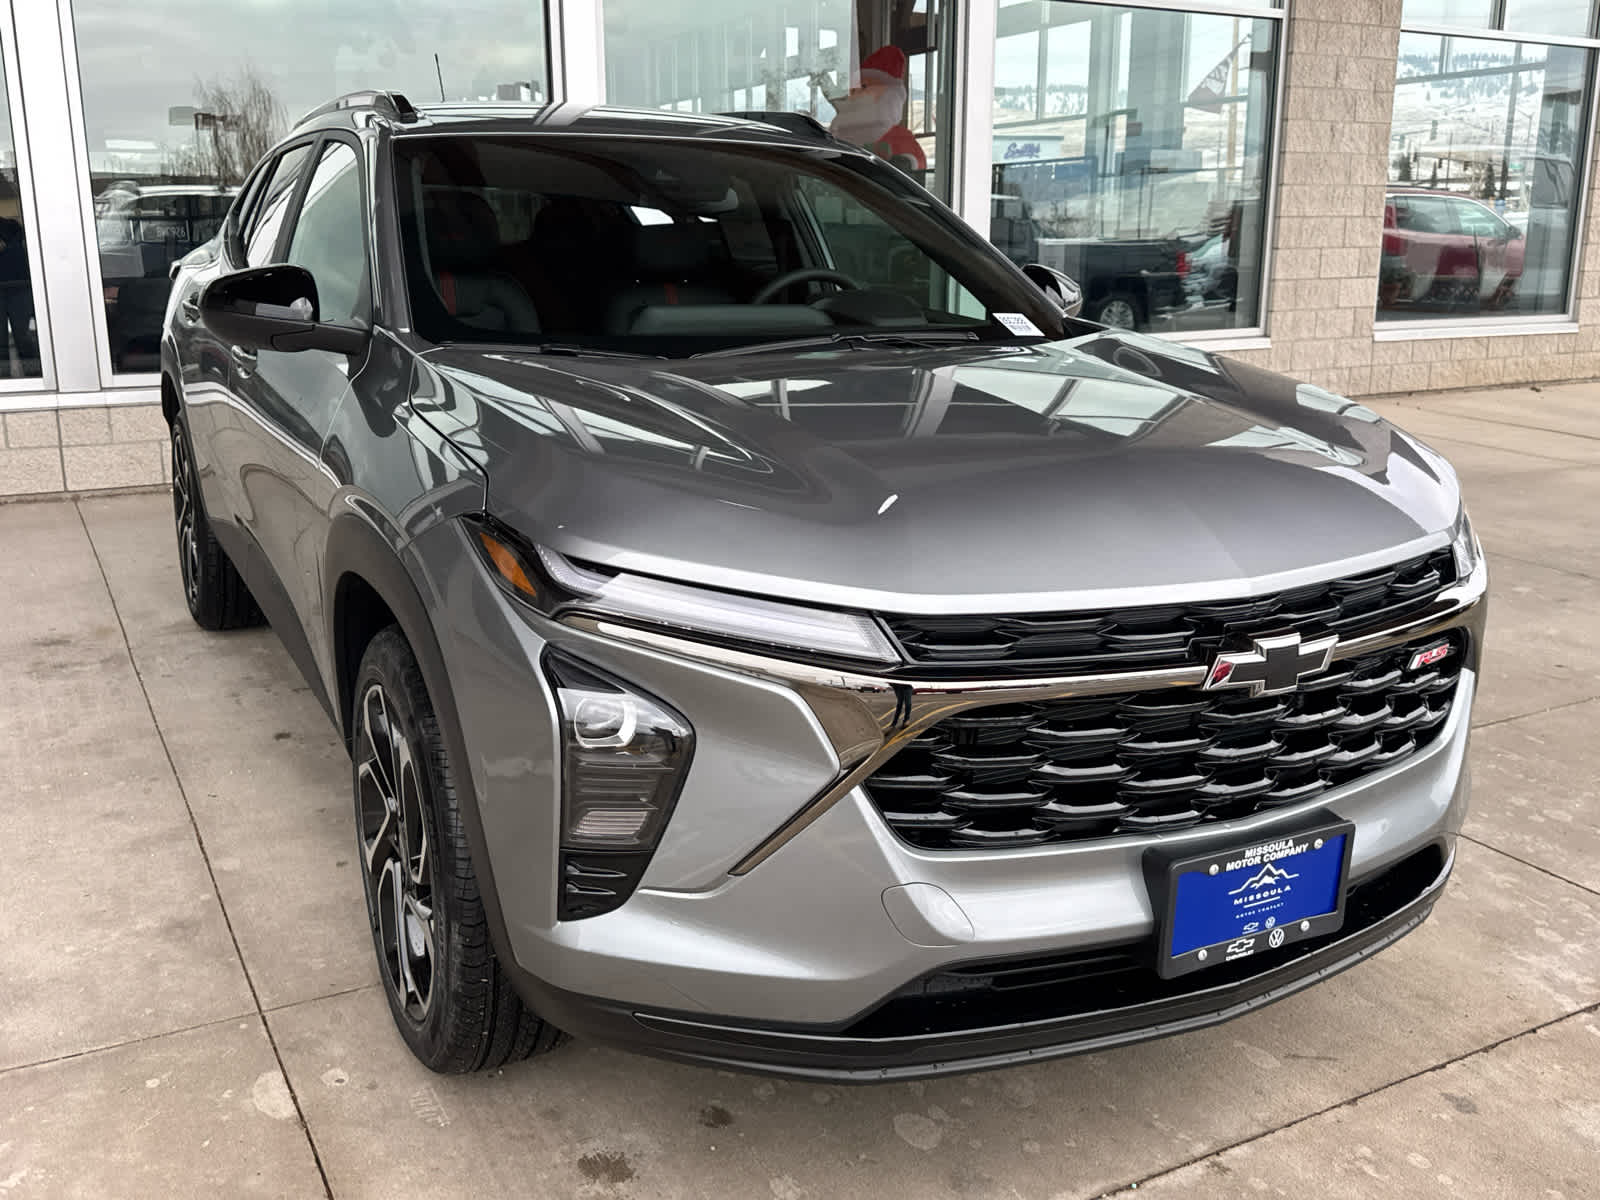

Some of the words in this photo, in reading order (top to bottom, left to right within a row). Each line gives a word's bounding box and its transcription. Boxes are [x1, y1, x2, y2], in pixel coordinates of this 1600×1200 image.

[1409, 643, 1450, 670] RS
[1226, 856, 1262, 872] MOTOR
[1263, 843, 1309, 862] COMPANY
[1245, 839, 1294, 858] MISSOULA
[1233, 885, 1291, 904] MISSOULA
